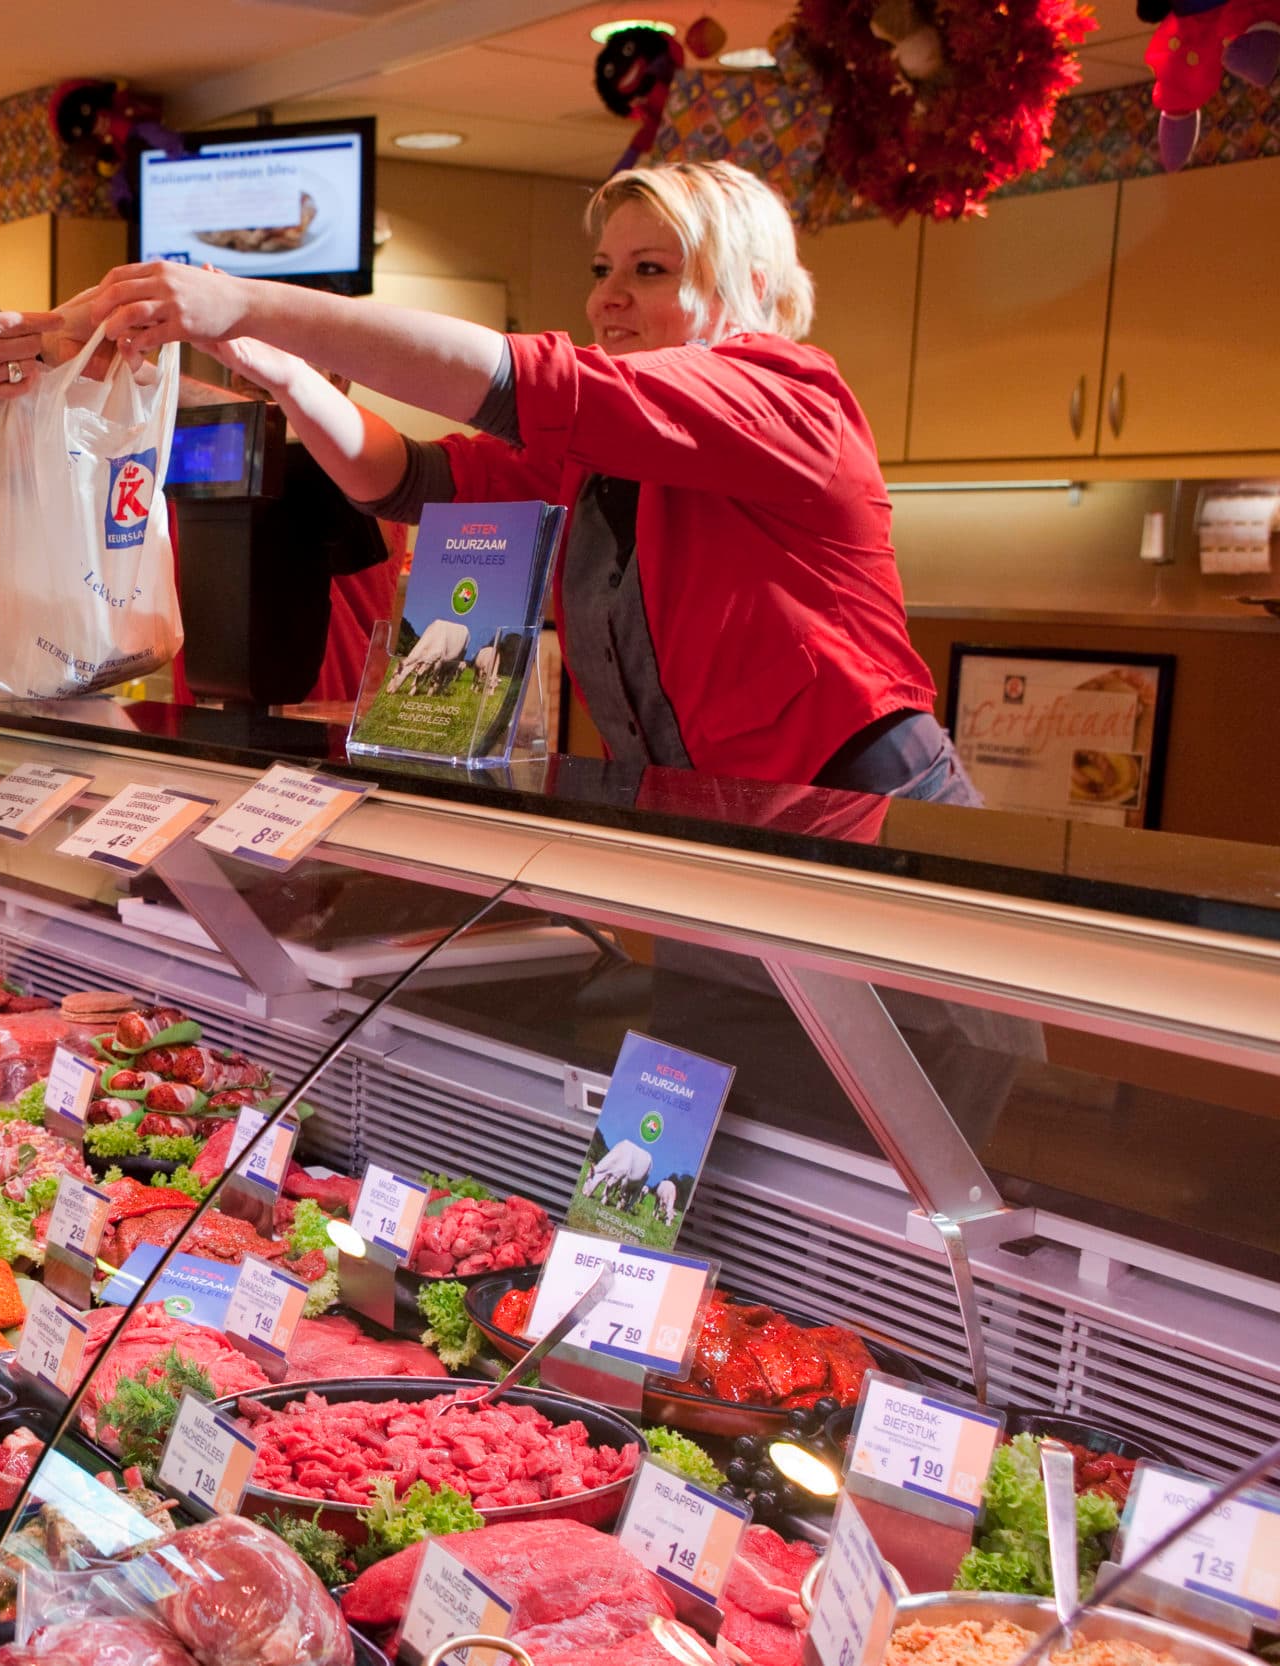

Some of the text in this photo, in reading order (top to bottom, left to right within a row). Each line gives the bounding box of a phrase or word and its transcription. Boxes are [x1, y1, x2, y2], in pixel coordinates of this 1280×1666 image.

[112, 478, 149, 521] K
[461, 523, 498, 535] KETEN
[445, 539, 507, 551] DUURZAAM
[440, 554, 506, 565] RUNDVLEES
[83, 570, 125, 608] Lekker
[397, 711, 451, 726] RUNDVLEES
[400, 700, 461, 714] NEDERLANDS
[966, 695, 1136, 752] Certificaat
[240, 804, 267, 816] VERSE
[294, 794, 309, 803] OF
[640, 1071, 695, 1099] DUURZAAM
[656, 1064, 688, 1081] KETEN
[635, 1084, 691, 1112] RUNDVLEES
[596, 1207, 646, 1238] NEDERLANDS
[573, 1251, 655, 1282] BIEFAASJES
[883, 1398, 942, 1427] ROERBAK-
[192, 1415, 218, 1441] MAGER
[882, 1413, 937, 1442] BIEFSTUK
[178, 1420, 225, 1465] HACHEEVLEES
[880, 1456, 888, 1467] €
[654, 1481, 704, 1518] RIBLAPPEN
[1163, 1492, 1232, 1520] KIPGOS
[422, 1572, 482, 1629] RUNDERLAPJES
